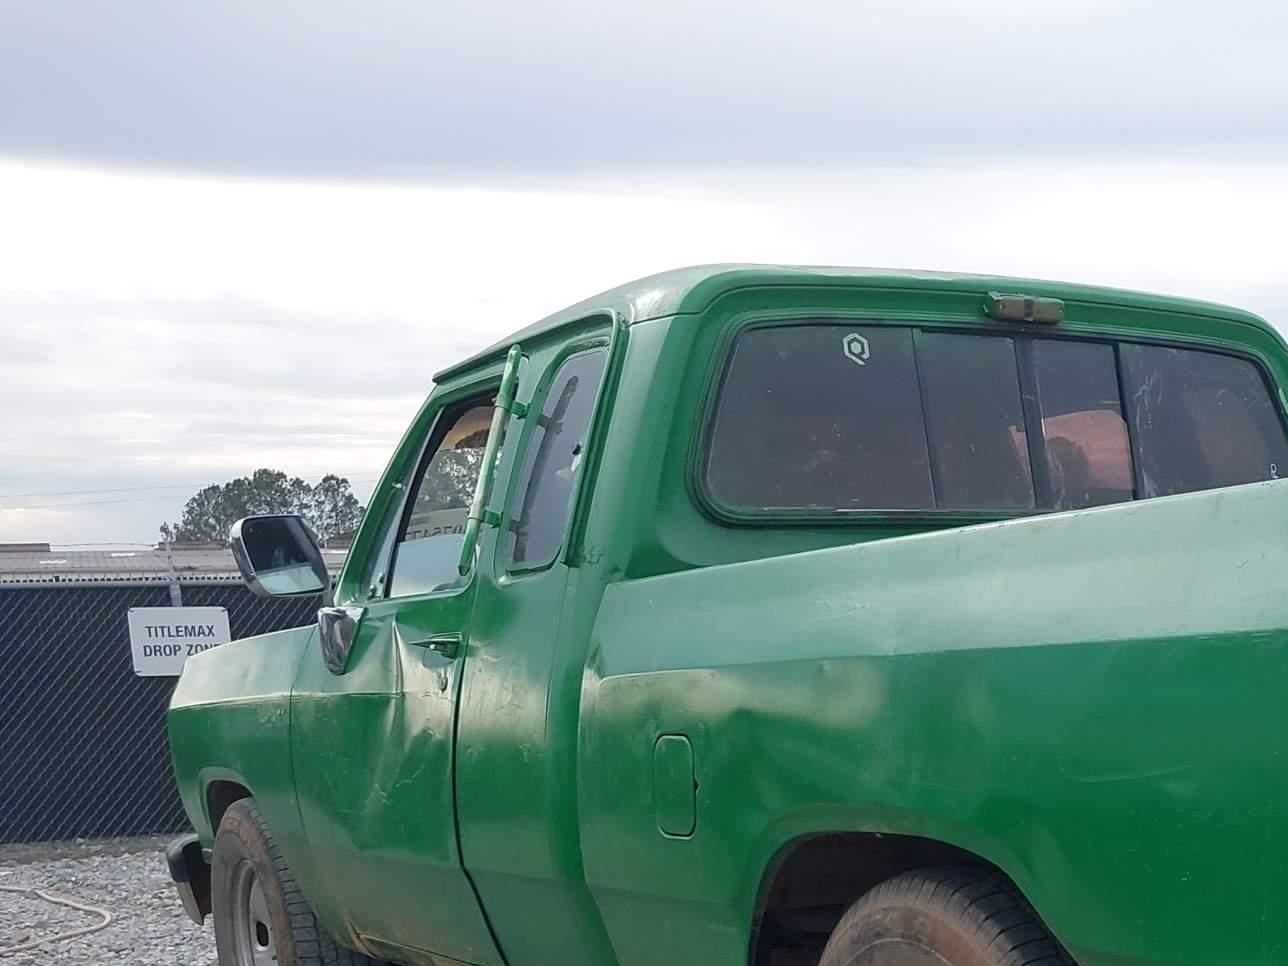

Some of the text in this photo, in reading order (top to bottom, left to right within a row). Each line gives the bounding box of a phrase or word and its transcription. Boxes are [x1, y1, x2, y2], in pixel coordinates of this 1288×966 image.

[145, 625, 215, 638] TITLEMAX
[143, 643, 221, 657] DROP ZO
